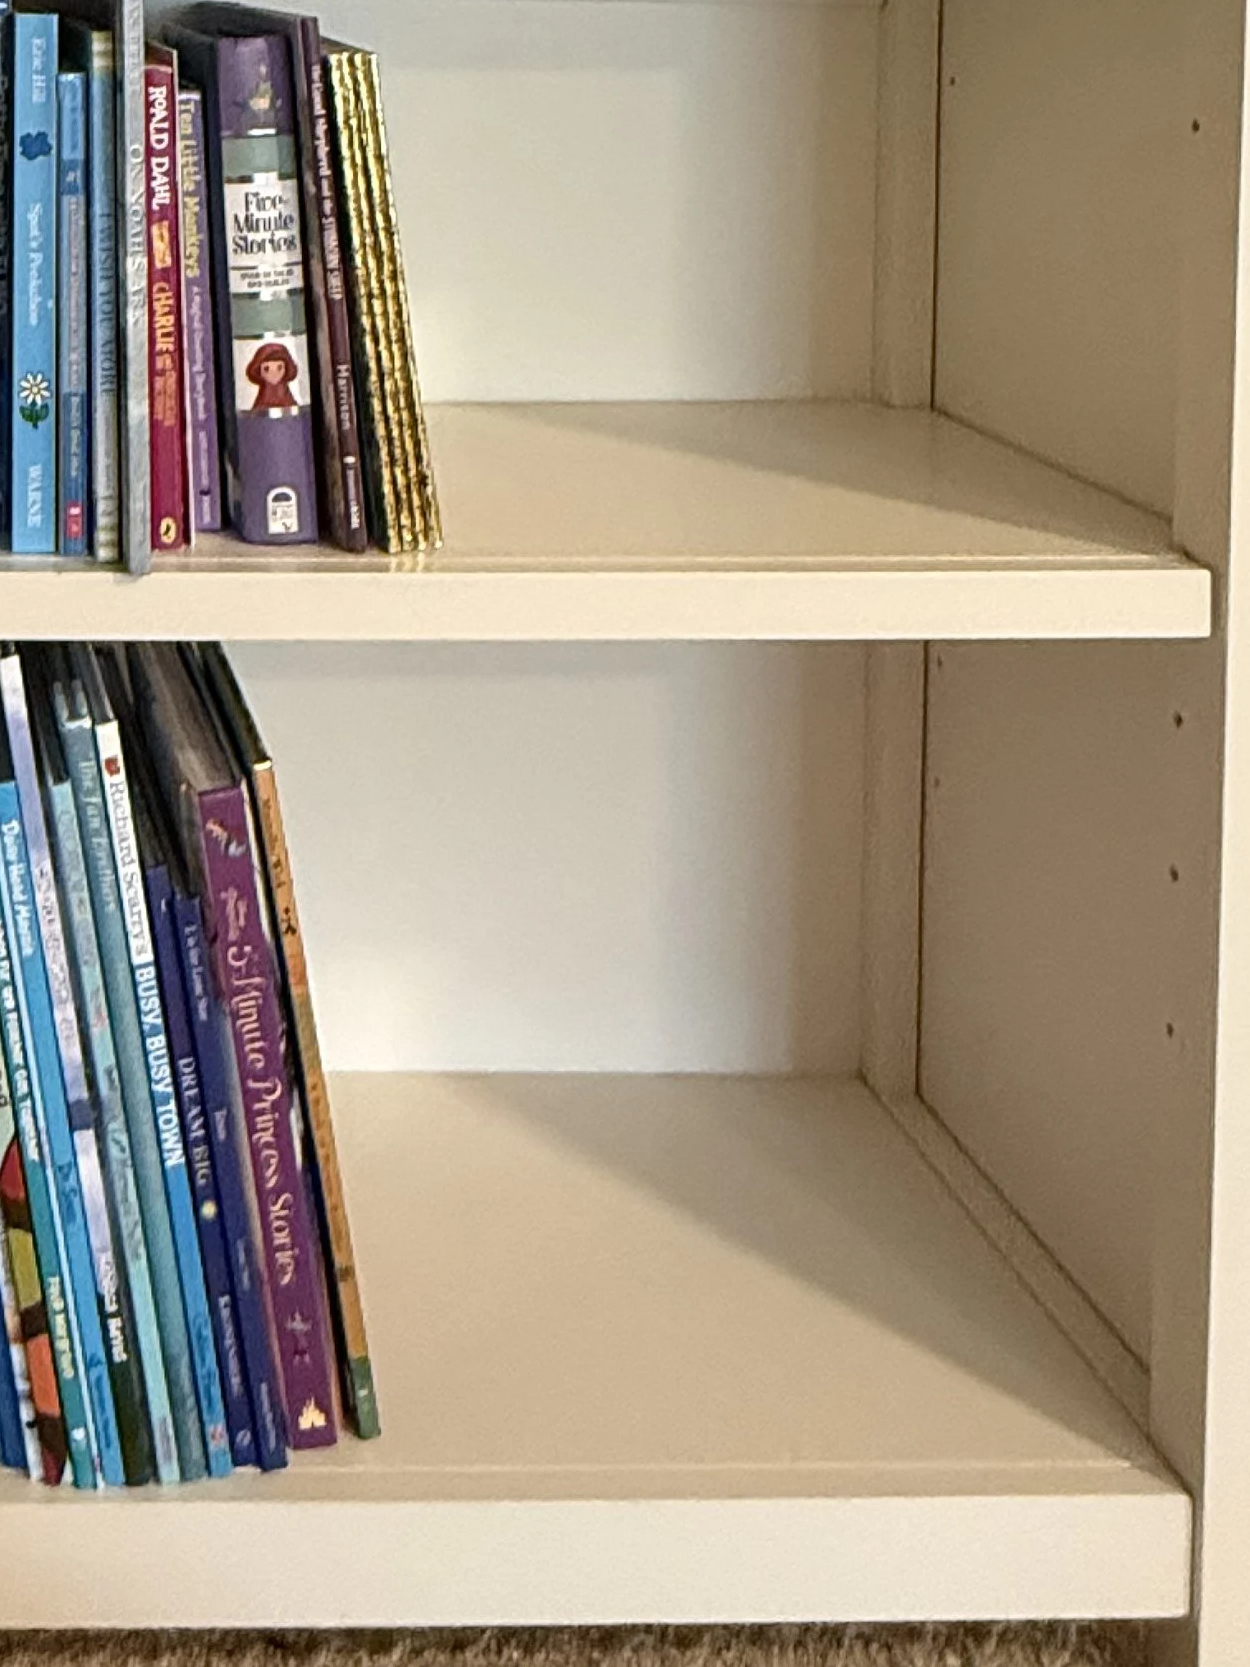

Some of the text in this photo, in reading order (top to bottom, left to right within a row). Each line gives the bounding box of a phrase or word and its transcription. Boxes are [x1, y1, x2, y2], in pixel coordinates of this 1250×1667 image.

[32, 37, 48, 103] Eric Hill
[129, 144, 146, 182] ON
[148, 86, 172, 209] ROALD DAHL
[179, 100, 203, 277] Ten Little Monkeys
[234, 211, 295, 233] Minute
[232, 233, 297, 256] Stories
[153, 282, 175, 352] CHARLIE
[336, 364, 354, 431] Harrison
[27, 464, 44, 527] WARNE
[109, 781, 183, 1167] Richard BUSY TOWN
[177, 1057, 212, 1186] DREAM BIG
[226, 945, 296, 1286] 5-Minute Princess Stories
